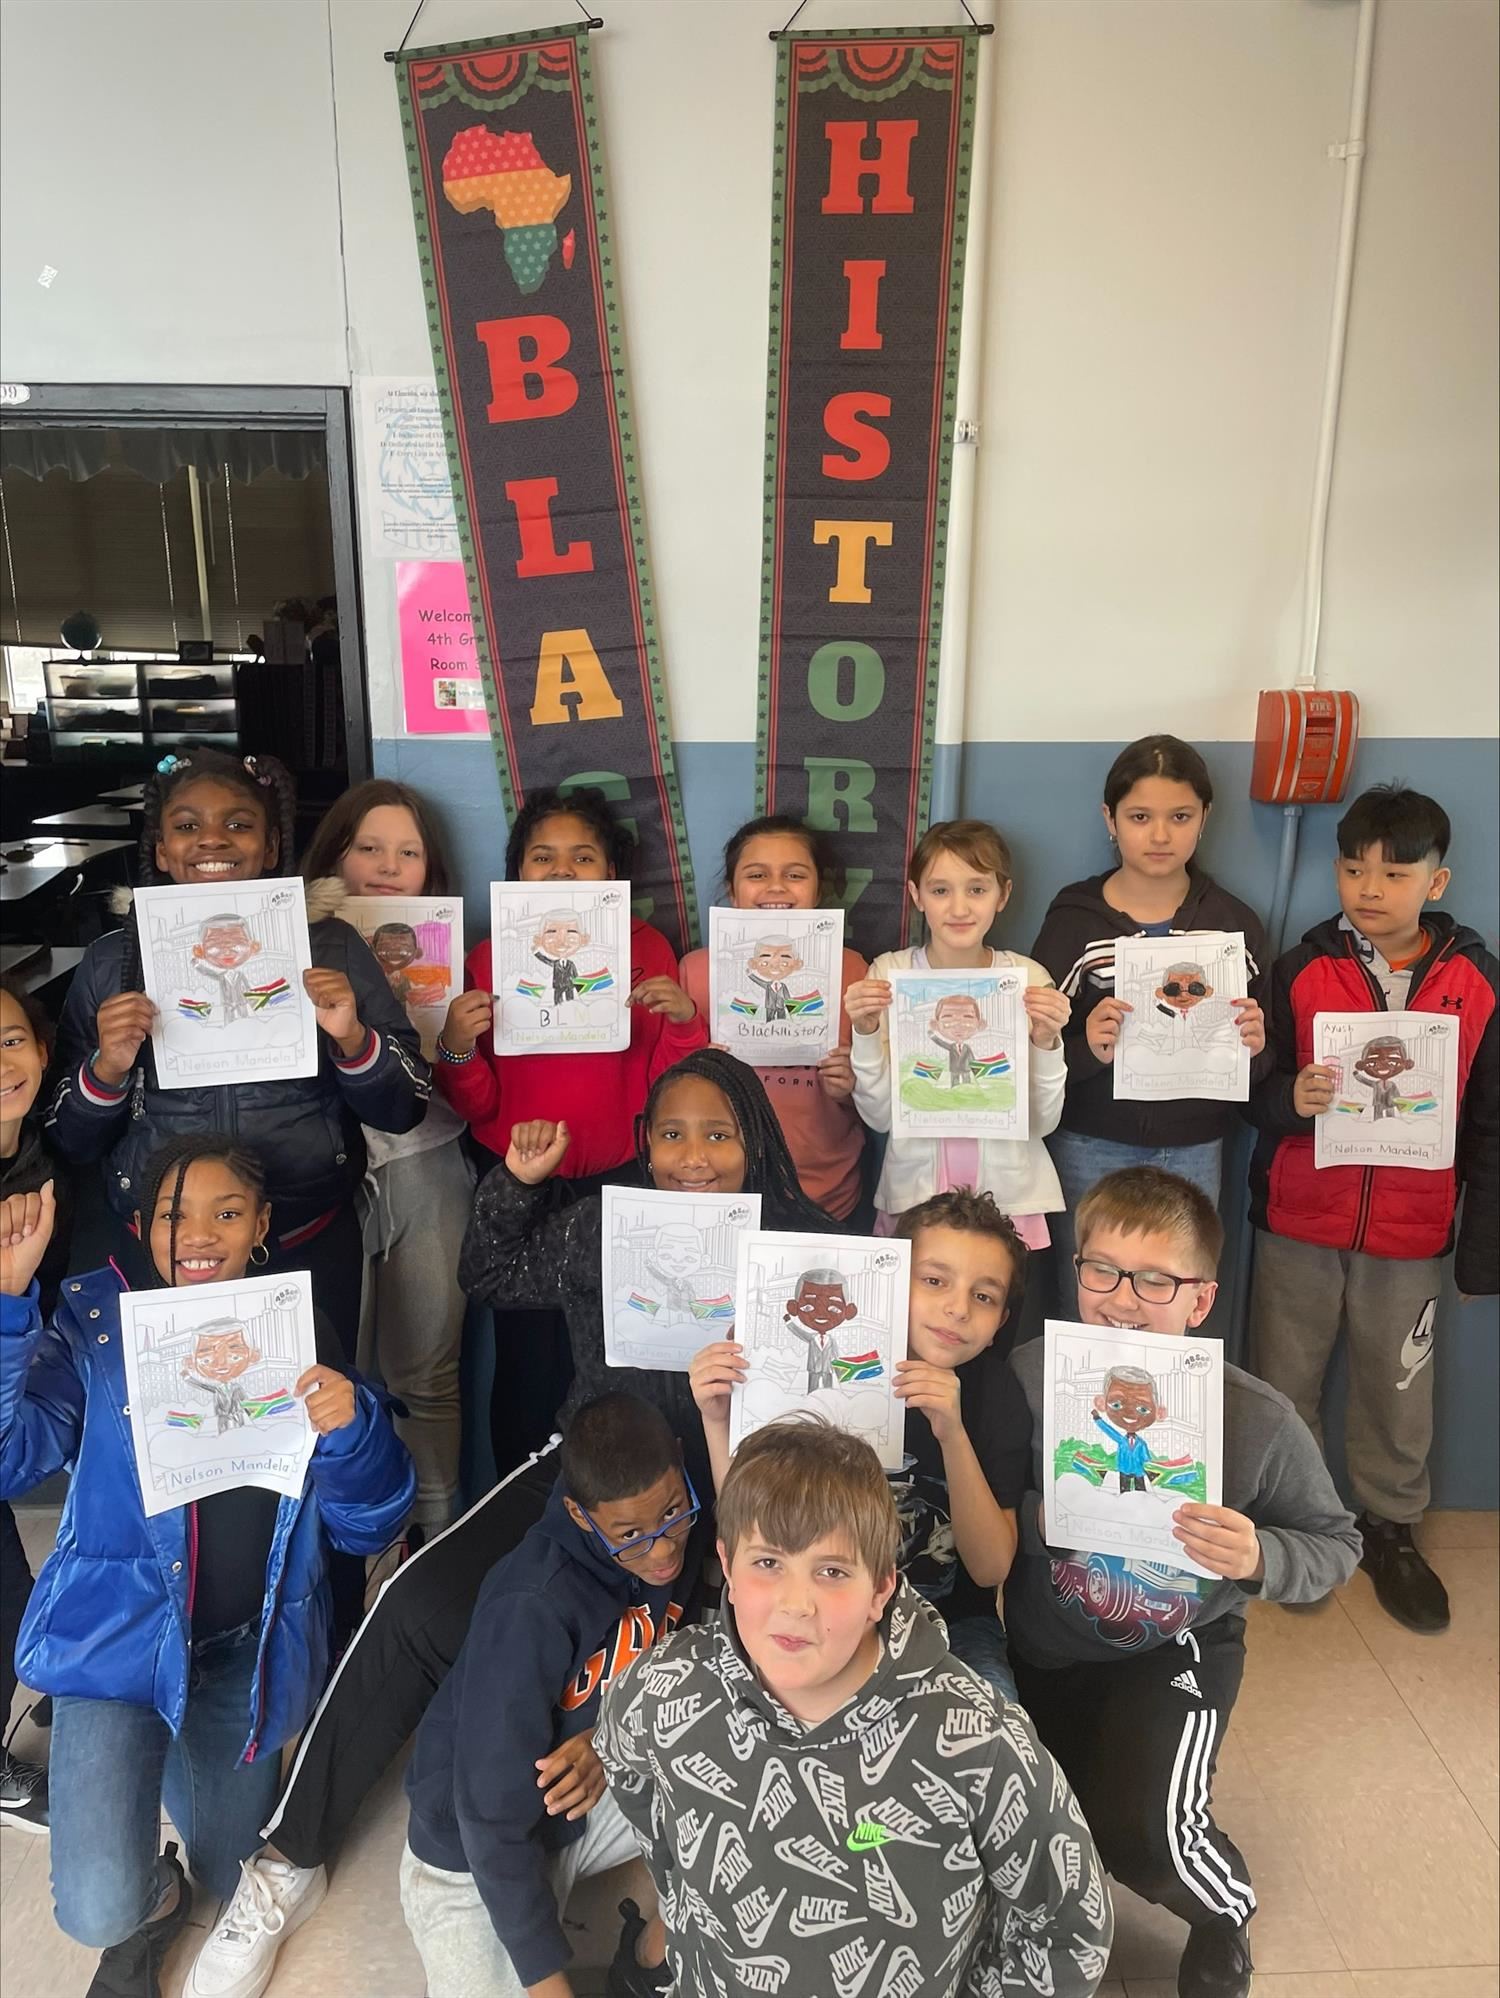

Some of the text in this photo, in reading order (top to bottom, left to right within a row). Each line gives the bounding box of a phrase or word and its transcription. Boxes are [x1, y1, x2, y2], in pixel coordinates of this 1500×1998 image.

[418, 609, 472, 623] Welcom
[427, 632, 475, 646] 4th Gr
[430, 657, 468, 671] Room
[1334, 1143, 1429, 1159] Nelson Mandela
[171, 1458, 290, 1488] Nelson Mandela
[1170, 1680, 1203, 1699] adidas
[656, 1692, 703, 1729] NIKE
[944, 1707, 992, 1736] NIKE
[859, 1711, 901, 1763] NIKE
[1003, 1716, 1039, 1765] NIKE
[684, 1751, 738, 1793] NIKE
[762, 1776, 798, 1832] NIKE
[818, 1767, 850, 1830] NIKE
[872, 1796, 933, 1836] NIKE
[912, 1779, 968, 1829] NIKE
[675, 1807, 700, 1848] NIKE
[855, 1822, 886, 1842] NIKE
[991, 1791, 1030, 1851] NIKE
[719, 1841, 753, 1895] NIKE
[792, 1834, 849, 1876] NIKE
[990, 1851, 1024, 1888] NIKE
[1066, 1841, 1081, 1890] NIKE
[731, 1885, 771, 1930] NIKE
[798, 1895, 849, 1922] NIKE
[863, 1858, 897, 1918] NIKE
[942, 1874, 983, 1922] NIKE
[829, 1936, 869, 1981] NIKE
[735, 1964, 781, 1995] NIKE
[886, 1962, 926, 1997] NIK
